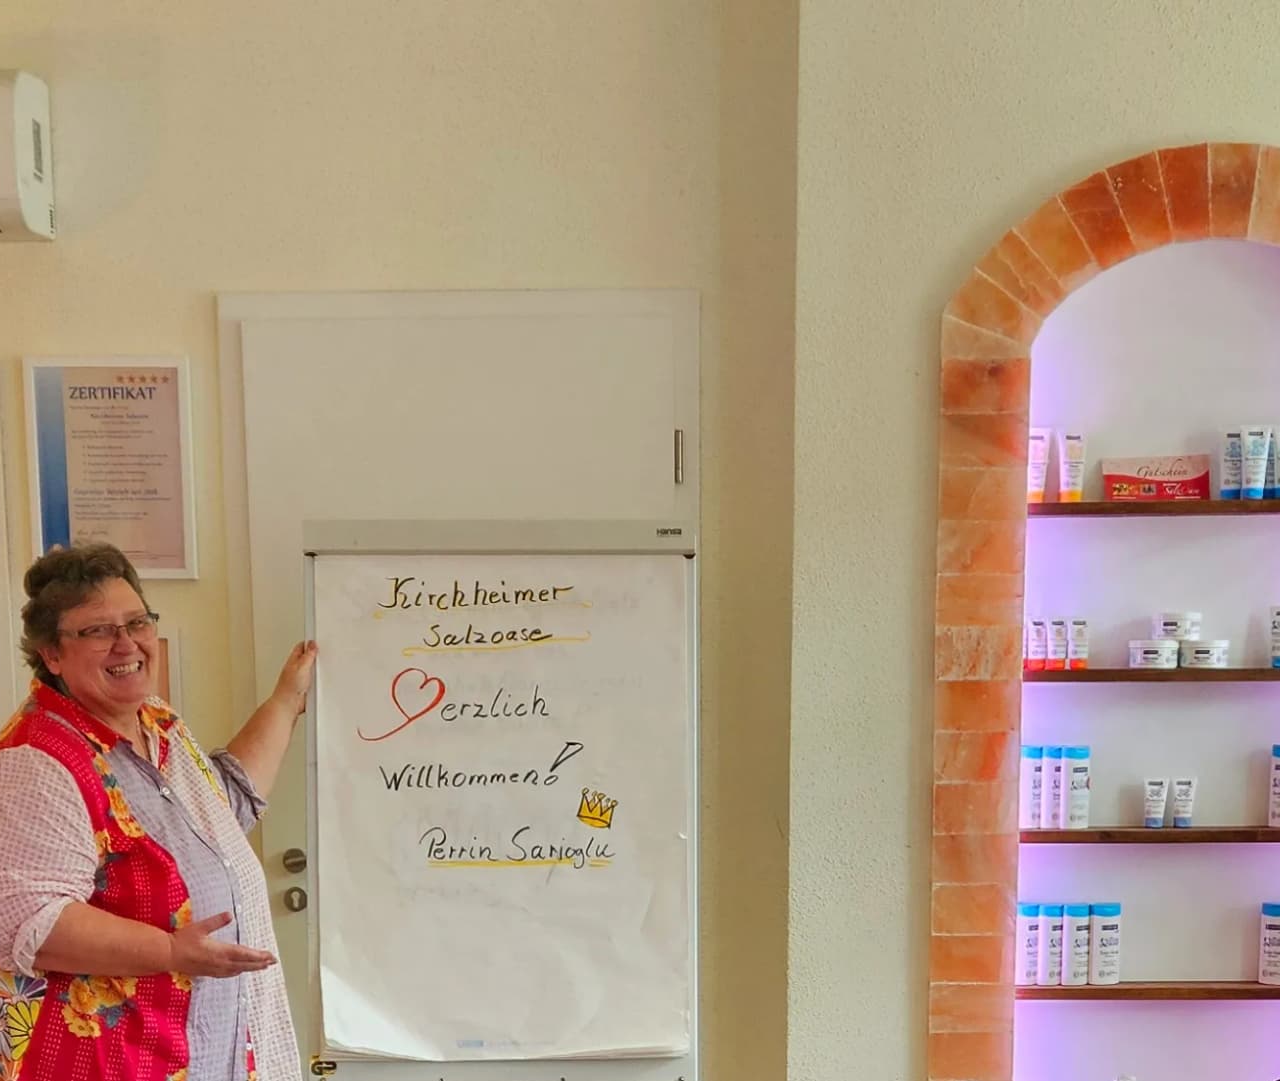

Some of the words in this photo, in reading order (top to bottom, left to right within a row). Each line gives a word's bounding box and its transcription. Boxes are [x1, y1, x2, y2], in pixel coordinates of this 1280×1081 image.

[69, 386, 156, 400] ZERTIFIKAT
[377, 577, 574, 610] Kirchheimer
[423, 624, 553, 648] Salzoase
[379, 741, 585, 791] Willkommen!
